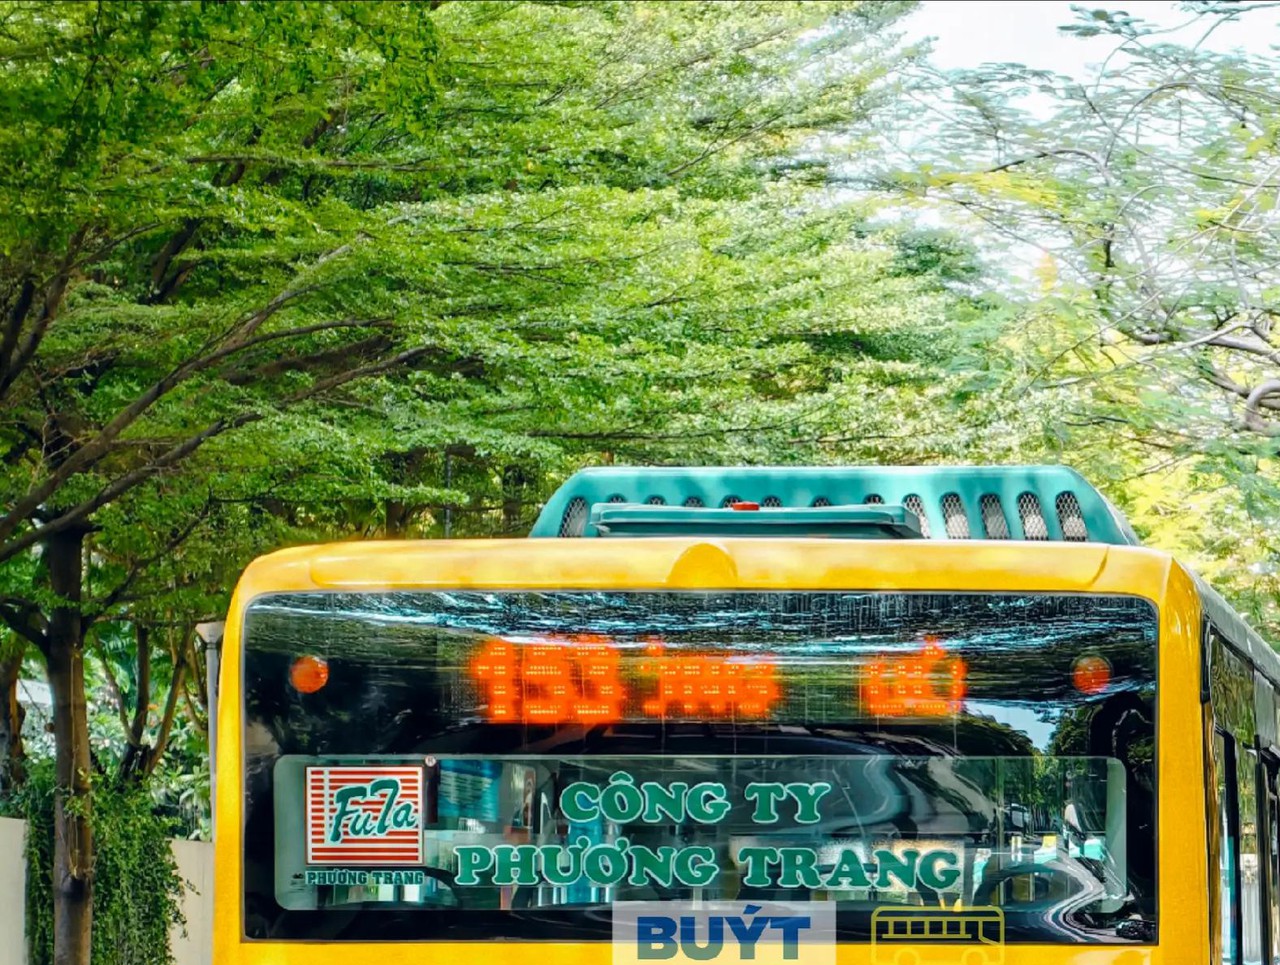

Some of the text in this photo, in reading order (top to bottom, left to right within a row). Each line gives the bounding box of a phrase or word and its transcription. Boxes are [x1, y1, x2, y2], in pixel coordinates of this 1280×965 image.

[559, 770, 831, 824] CÔNG TY
[371, 870, 425, 885] TRANG
[453, 835, 962, 890] PHƯƠNG TRANG
